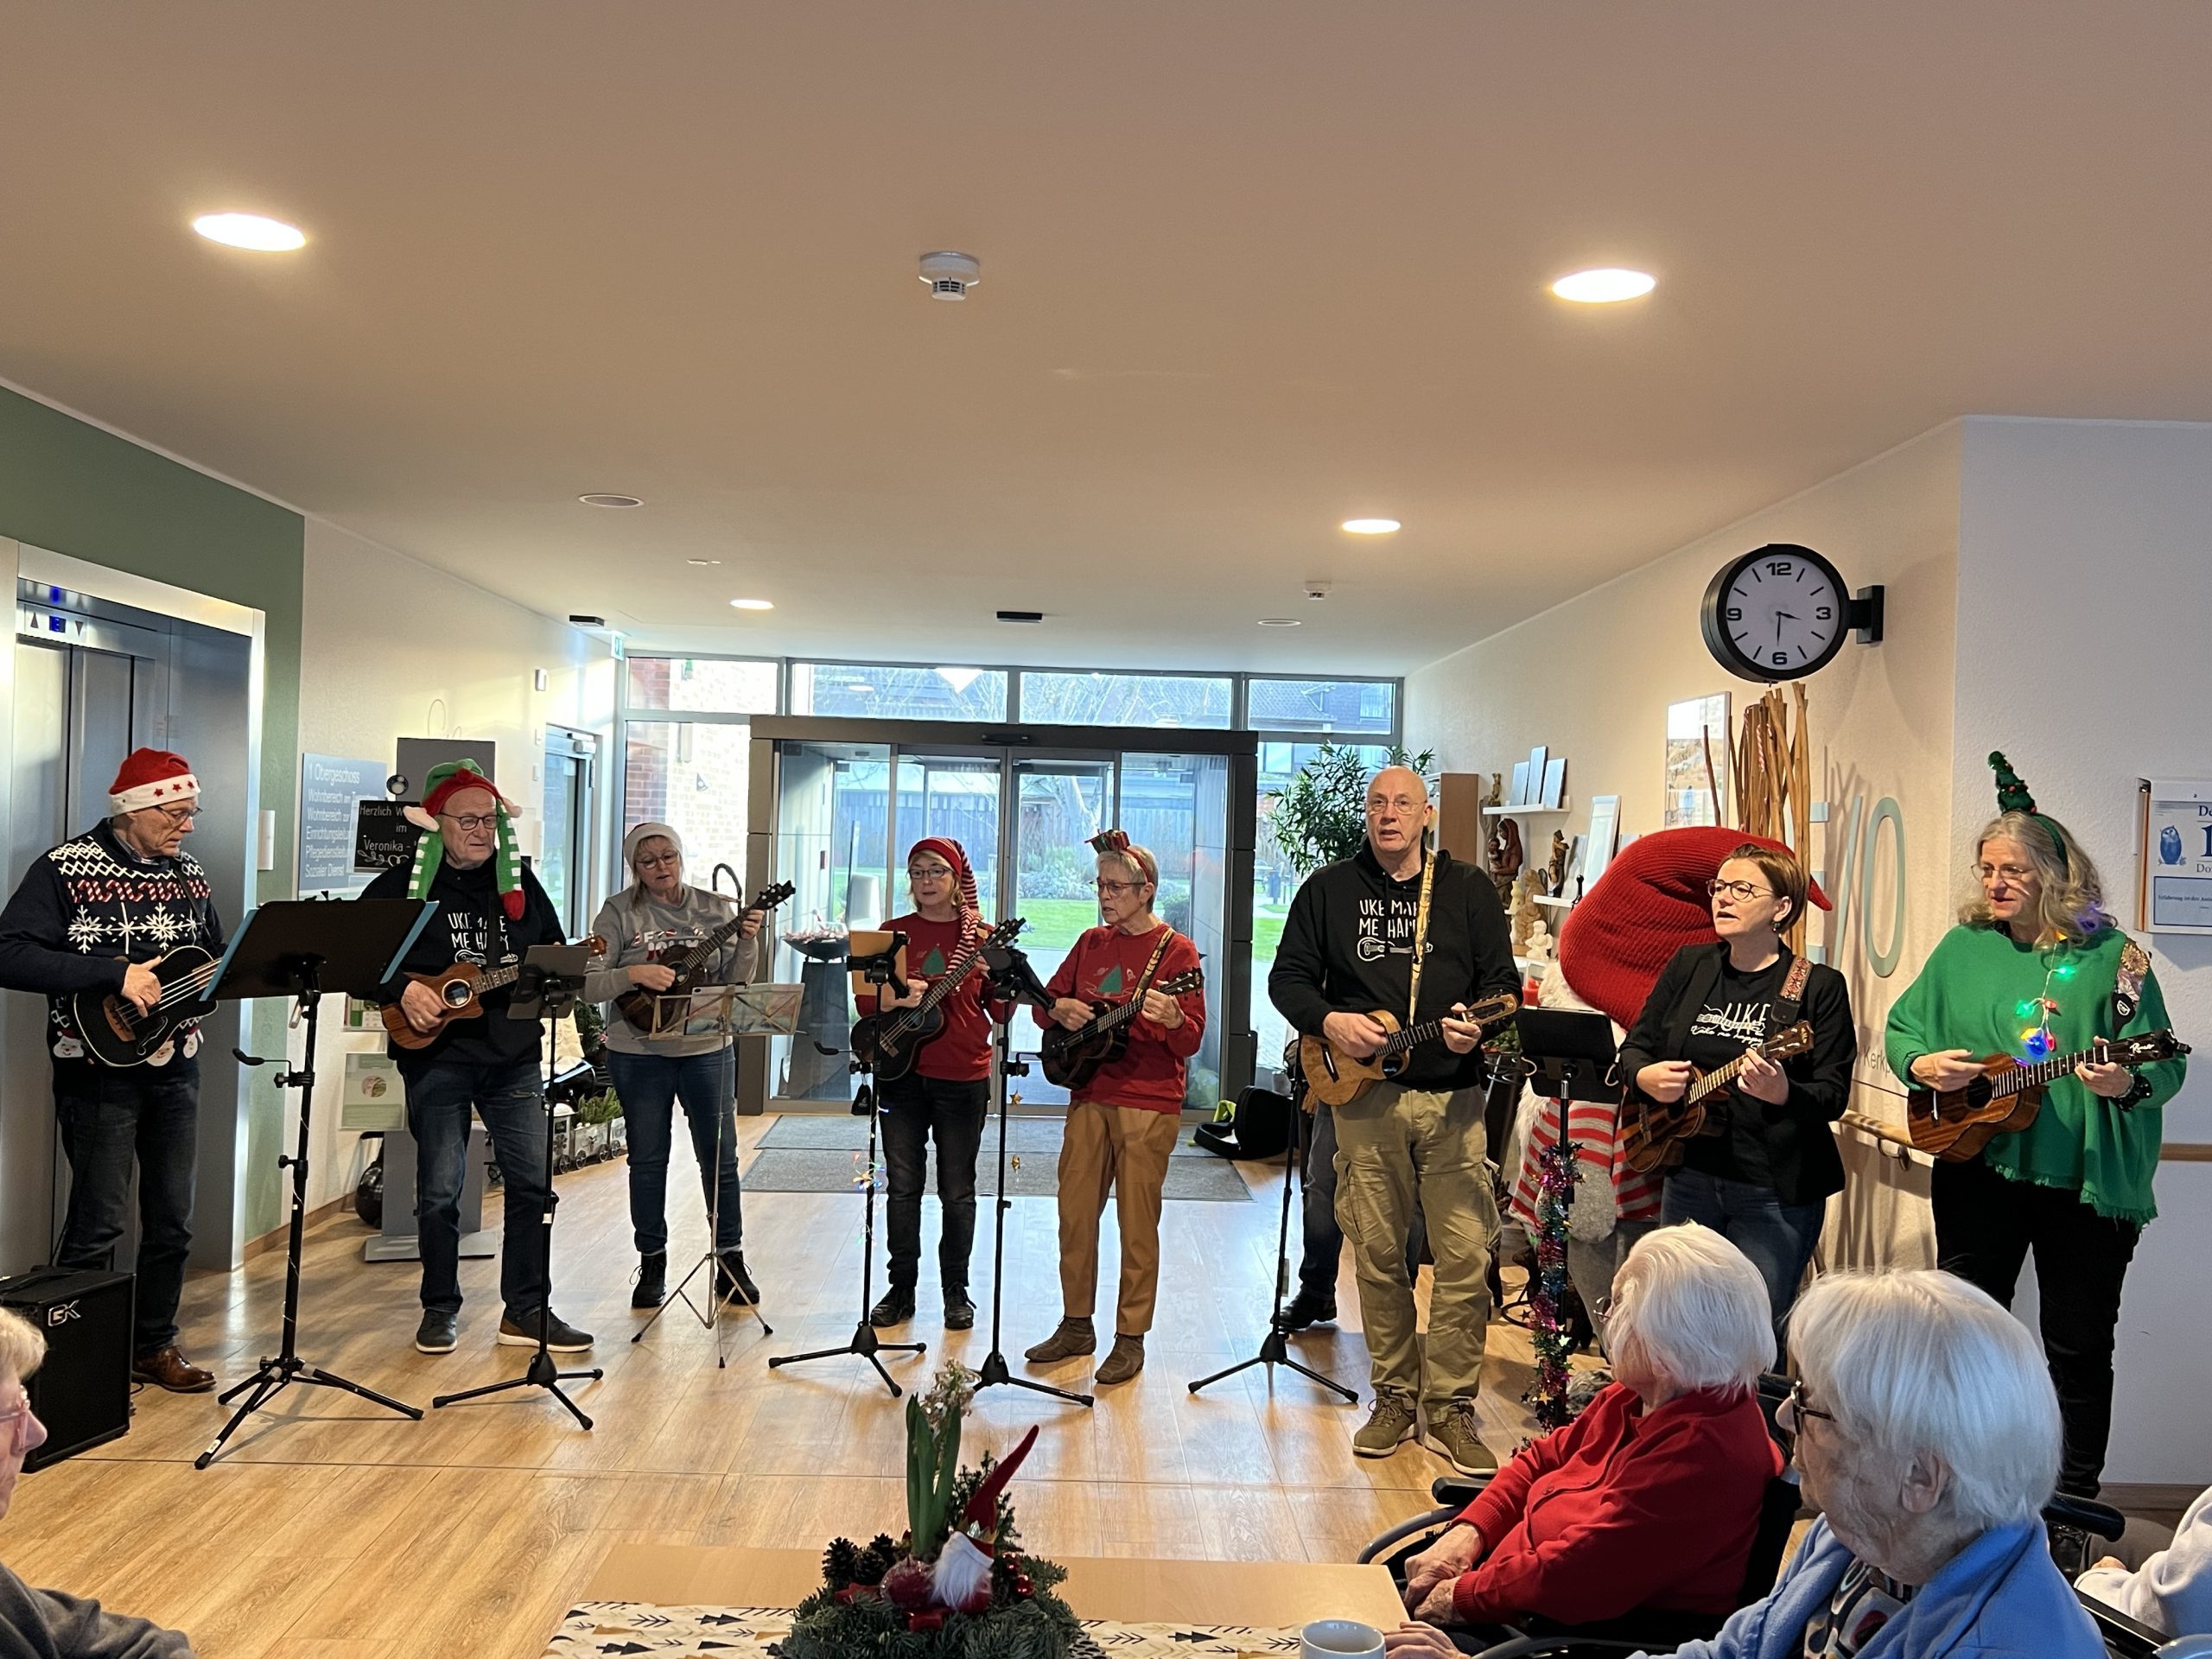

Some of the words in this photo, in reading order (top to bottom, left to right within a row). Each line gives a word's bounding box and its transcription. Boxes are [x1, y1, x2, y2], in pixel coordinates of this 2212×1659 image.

[1766, 562, 1792, 576] 12
[1726, 607, 1743, 621] 9
[1815, 607, 1831, 620] 3
[1772, 652, 1788, 665] 6
[359, 805, 392, 817] Herzlich
[396, 823, 407, 833] im
[364, 839, 404, 852] Veronika
[2196, 863, 2212, 874] Do
[1359, 899, 1384, 916] UKE
[1358, 918, 1379, 936] ME
[451, 931, 471, 950] ME
